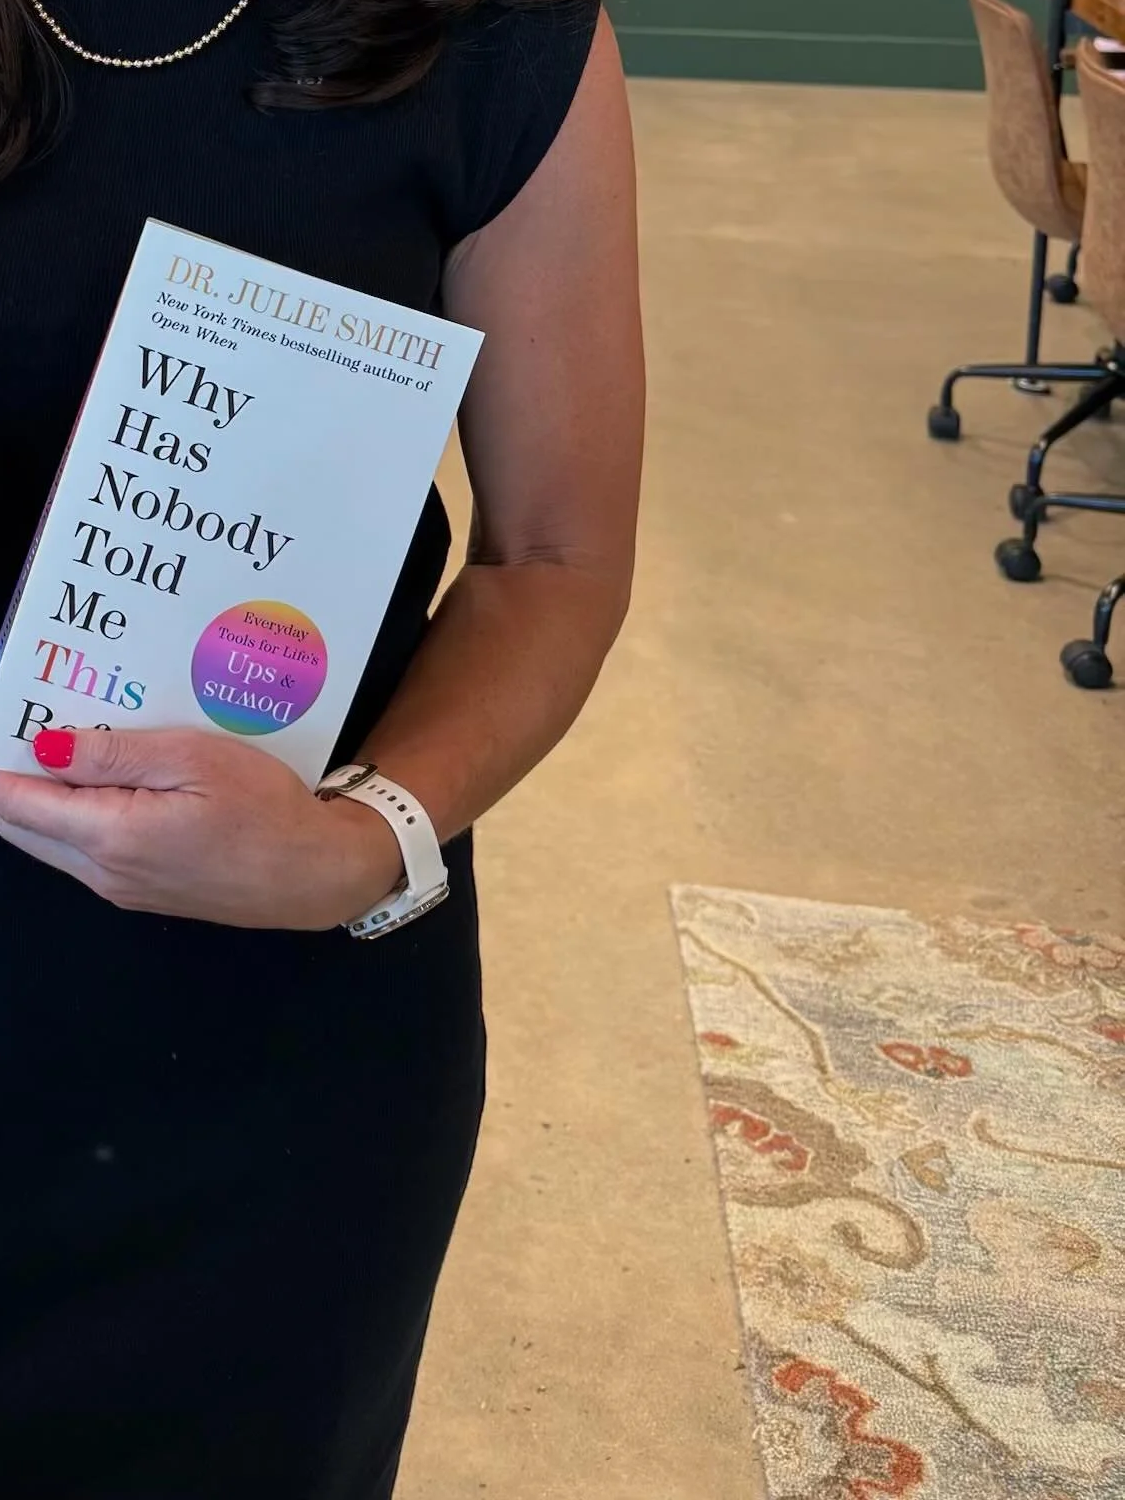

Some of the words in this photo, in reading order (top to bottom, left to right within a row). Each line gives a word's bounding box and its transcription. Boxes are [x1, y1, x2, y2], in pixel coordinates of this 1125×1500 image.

[151, 311, 191, 336] Open
[195, 325, 238, 351] When
[157, 291, 189, 313] New
[191, 303, 228, 326] York
[231, 317, 277, 343] Times
[280, 333, 361, 373] bestselling
[363, 361, 421, 387] author
[415, 380, 433, 393] of
[165, 254, 219, 298] DR.
[228, 279, 332, 334] JULIE
[334, 313, 446, 371] SMITH
[138, 345, 256, 429] Why
[107, 403, 212, 473] Has
[88, 462, 295, 572] Nobody
[72, 521, 187, 596] Told
[49, 580, 128, 640] Me
[243, 611, 309, 643] Everyday
[34, 639, 146, 711] This
[218, 626, 256, 649] Tools
[258, 639, 280, 655] for
[282, 646, 320, 667] Life's
[227, 650, 277, 685] Ups
[280, 674, 296, 689] &
[203, 680, 295, 724] Downs
